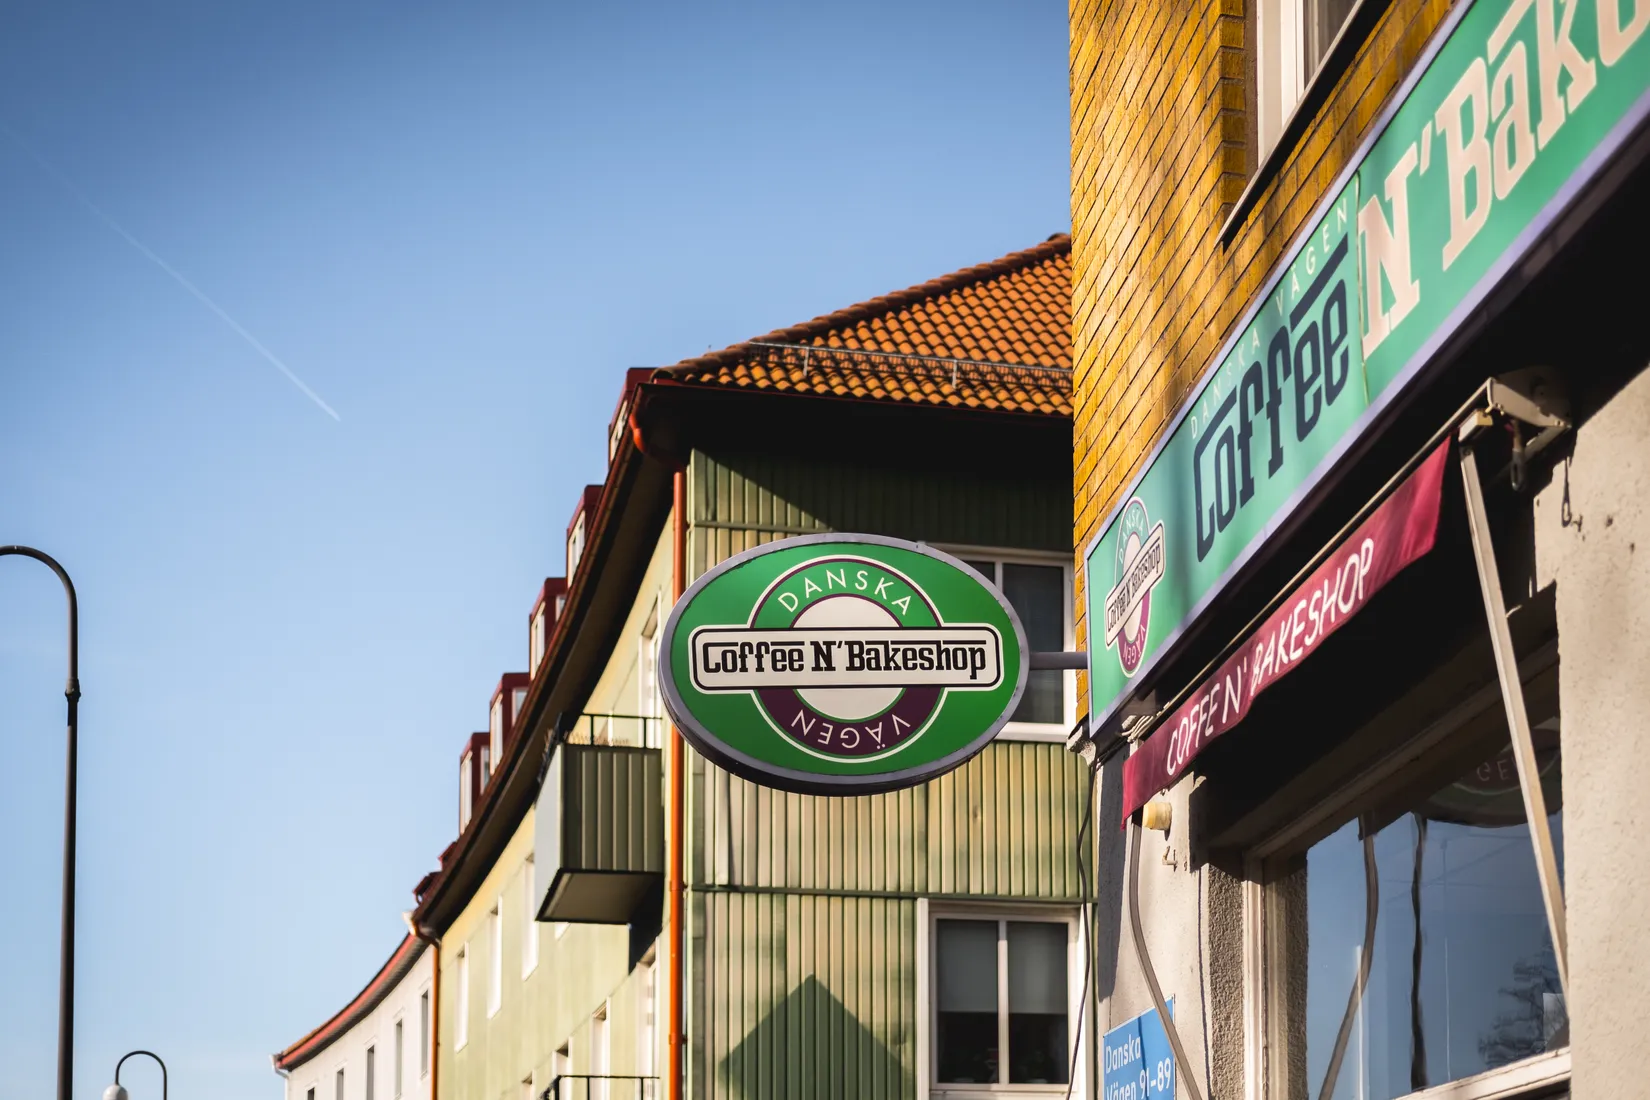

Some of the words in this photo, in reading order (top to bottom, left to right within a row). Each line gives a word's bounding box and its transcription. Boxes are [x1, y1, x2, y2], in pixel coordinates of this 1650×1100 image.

[1191, 327, 1260, 440] DANSKA
[1276, 198, 1348, 317] VÄGEN
[1193, 231, 1349, 563] Coffee
[778, 568, 912, 616] DANSKA
[1250, 538, 1374, 697] BAKESHOP
[702, 640, 805, 673] Coffee
[791, 709, 911, 751] VÄGEN
[1105, 1034, 1141, 1074] Danska
